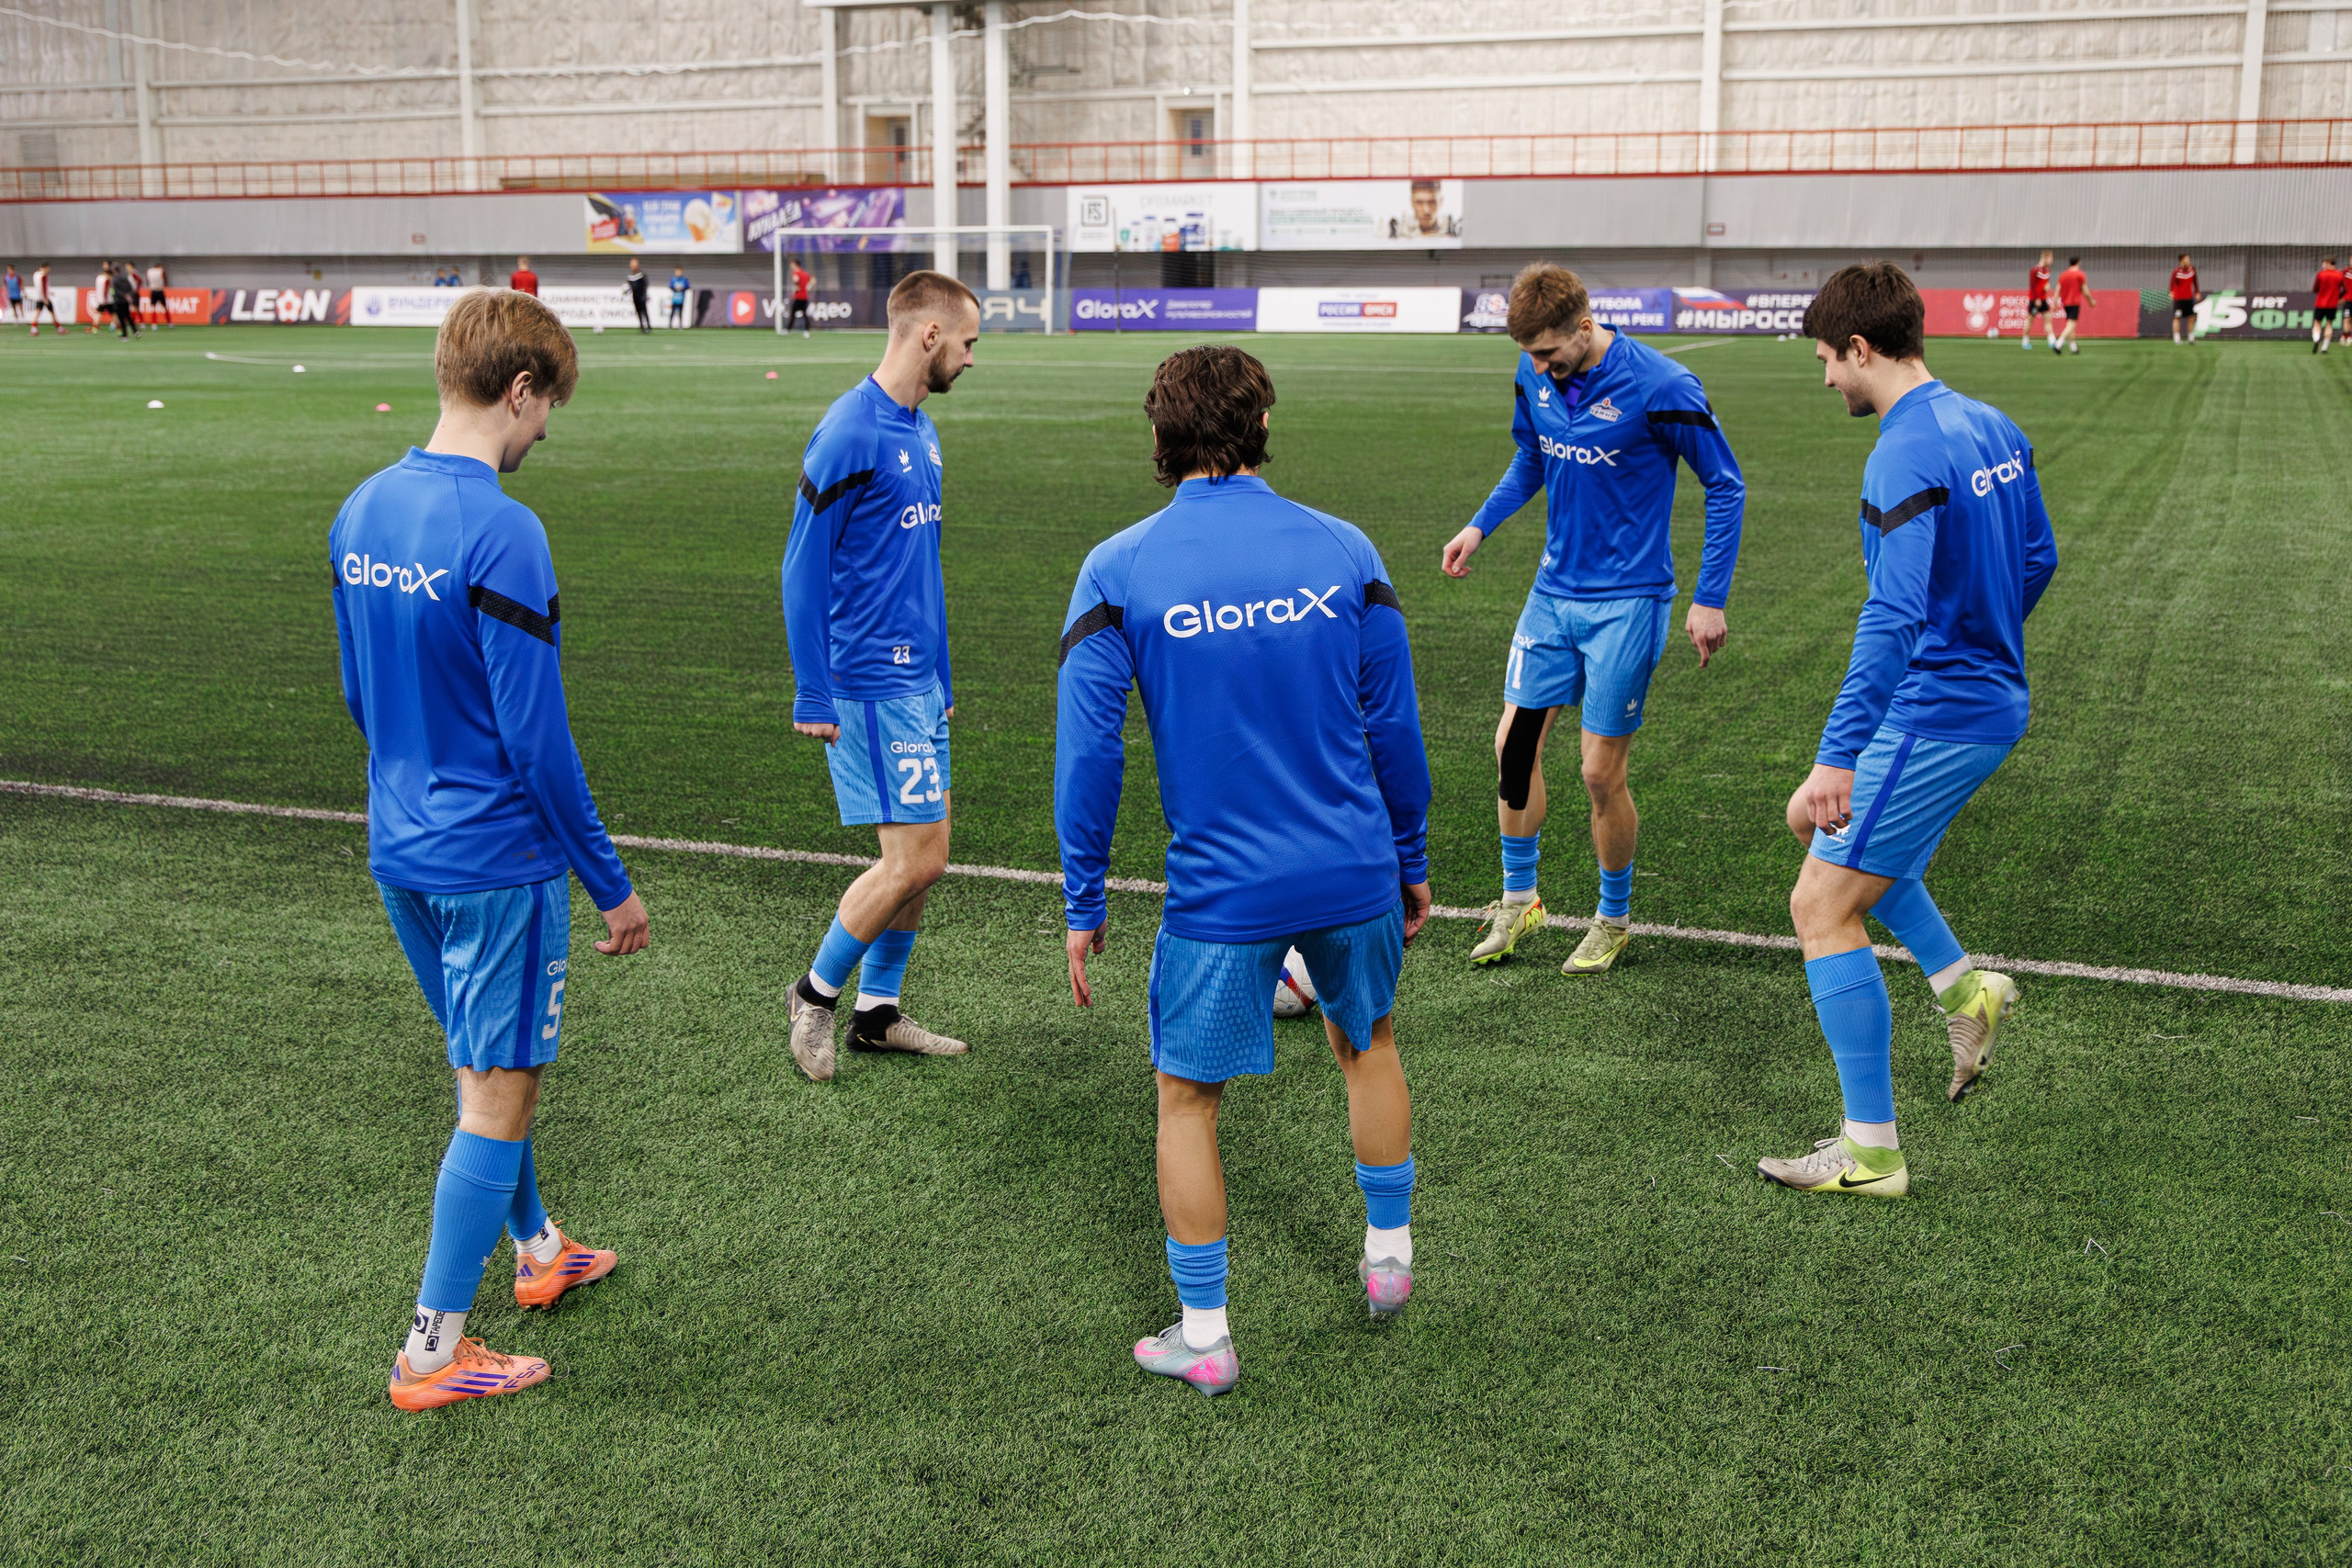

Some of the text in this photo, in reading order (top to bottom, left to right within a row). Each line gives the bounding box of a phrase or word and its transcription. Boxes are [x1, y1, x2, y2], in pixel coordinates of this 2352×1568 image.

[1076, 299, 1159, 320] GloraX
[1747, 294, 1816, 309] #ВПЕРЕ
[2193, 296, 2248, 333] 15
[2251, 296, 2288, 309] лет
[1539, 434, 1622, 467] GloraX
[343, 552, 450, 602] GloraX
[1163, 585, 1342, 639] GloraX
[892, 645, 911, 665] 23
[898, 756, 943, 805] 23
[541, 977, 566, 1041] 5
